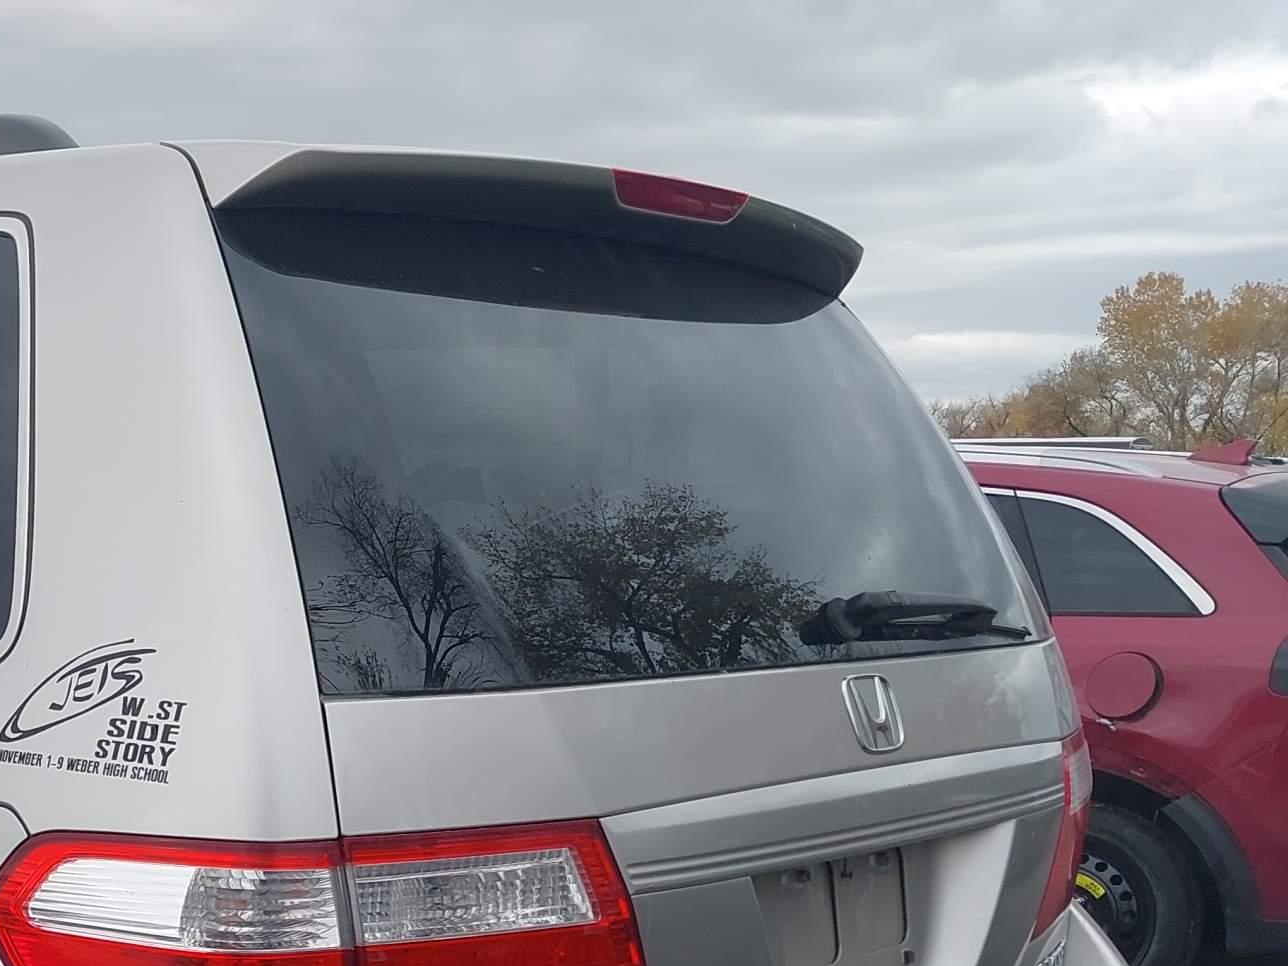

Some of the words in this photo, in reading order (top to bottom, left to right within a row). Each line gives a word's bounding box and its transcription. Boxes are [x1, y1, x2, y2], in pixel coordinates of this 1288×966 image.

[121, 695, 188, 722] WST
[106, 717, 181, 746] SIDE
[94, 738, 176, 767] STORY
[46, 754, 65, 770] 1-9
[66, 757, 101, 775] WEBER
[102, 762, 129, 779] HIGH
[130, 766, 169, 784] SCHOOL
